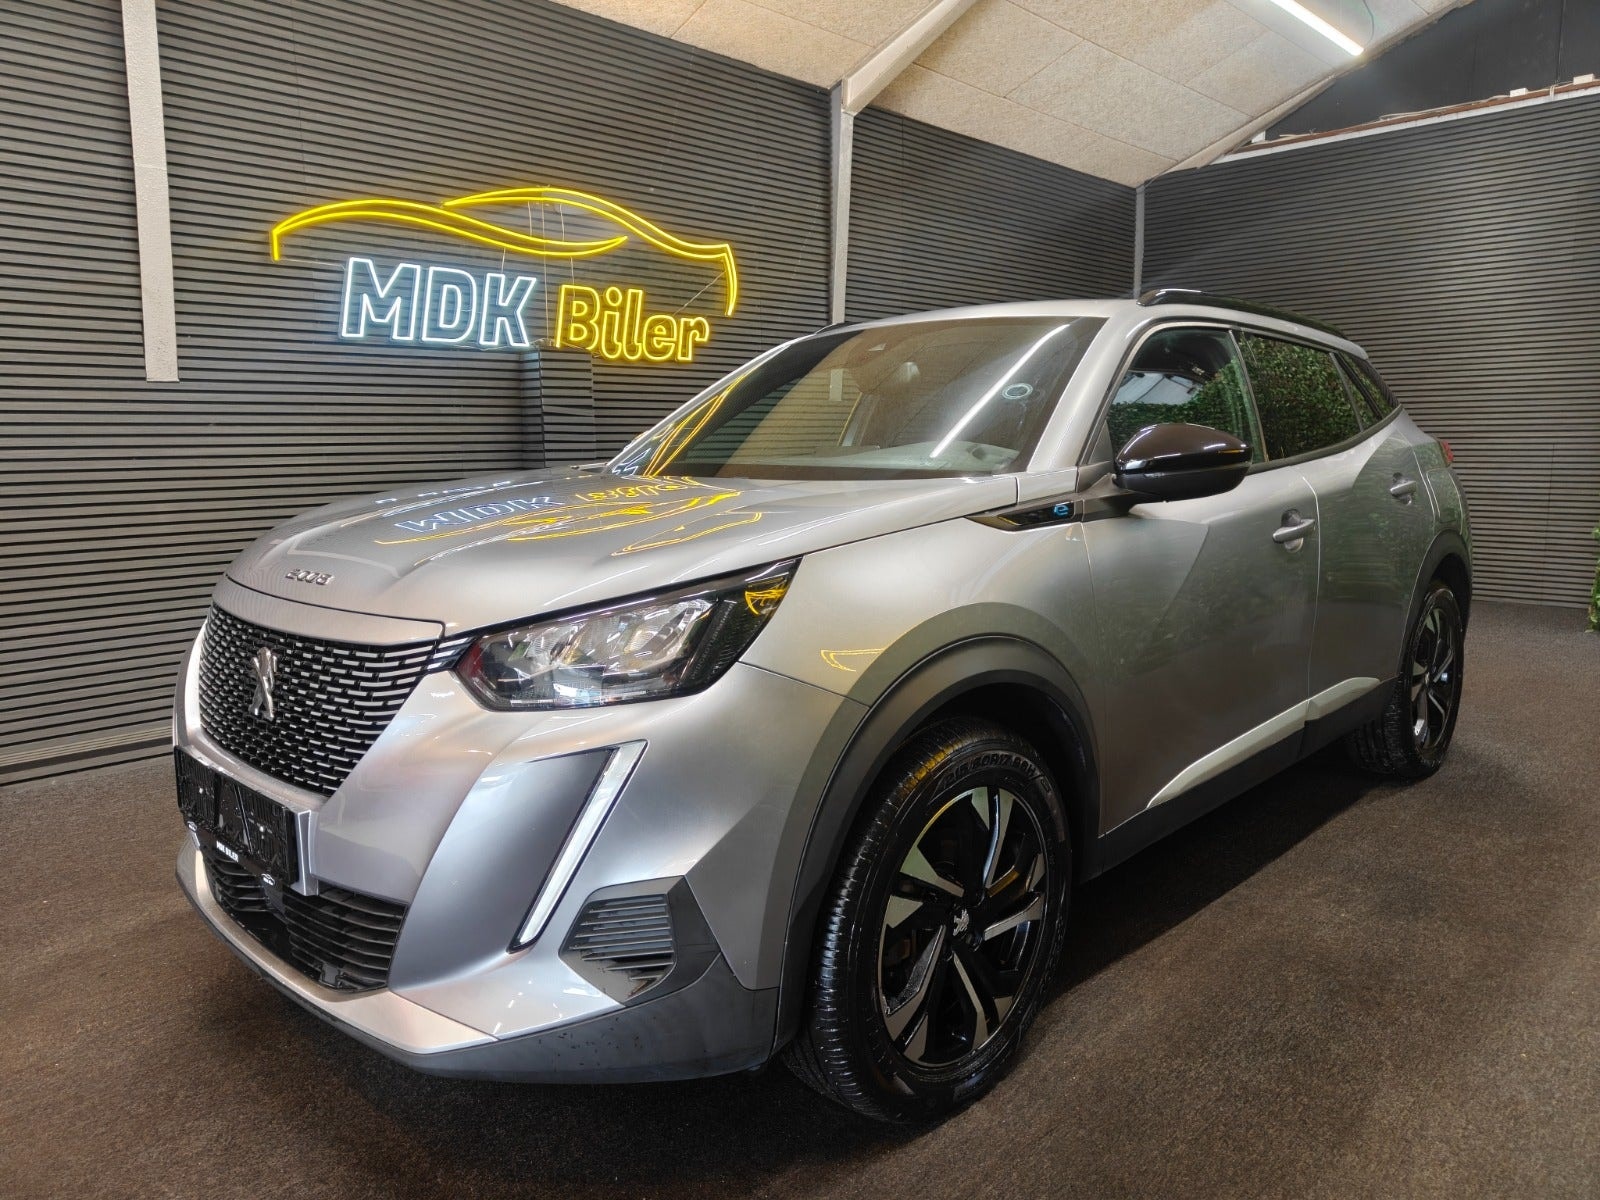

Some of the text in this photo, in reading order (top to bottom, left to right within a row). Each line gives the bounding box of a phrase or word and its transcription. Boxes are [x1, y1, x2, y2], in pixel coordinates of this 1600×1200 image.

[341, 256, 711, 361] MDK Biler
[284, 569, 334, 585] 2008
